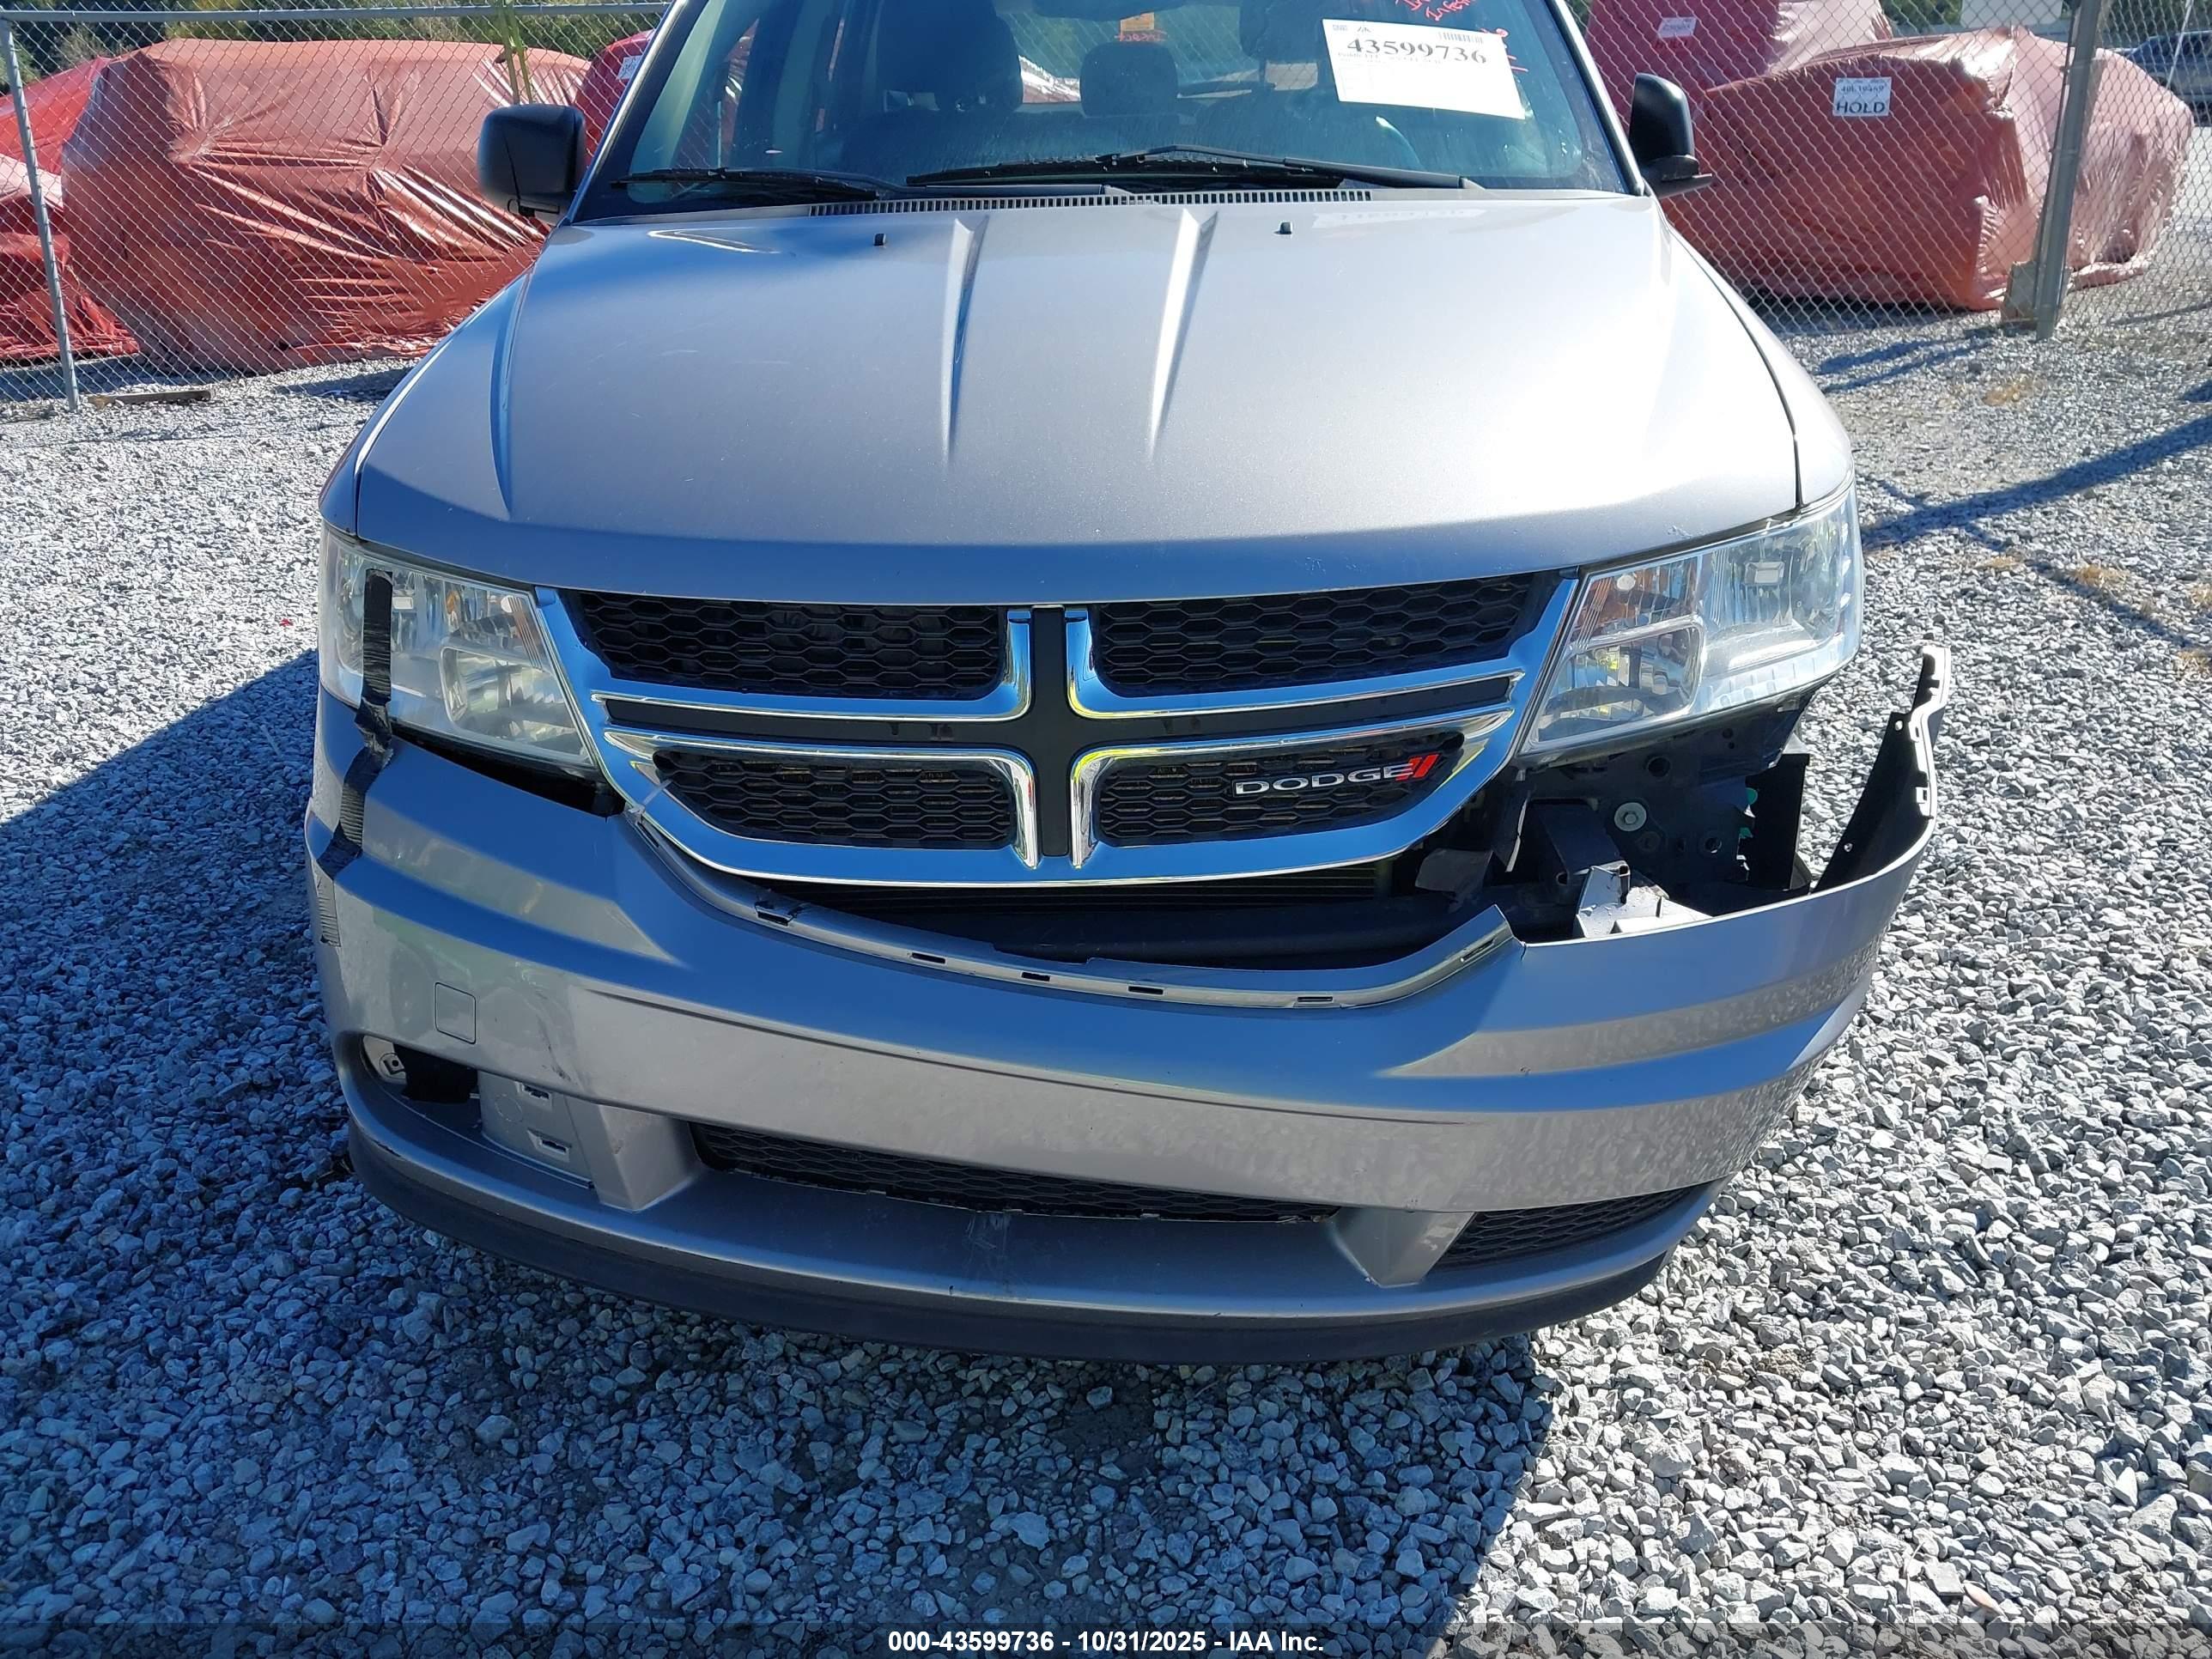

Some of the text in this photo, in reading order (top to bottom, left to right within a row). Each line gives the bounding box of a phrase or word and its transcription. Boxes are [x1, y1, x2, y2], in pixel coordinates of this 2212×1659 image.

[1346, 39, 1486, 64] 43599736
[1837, 100, 1886, 114] HOLD
[1235, 763, 1414, 795] DODGE
